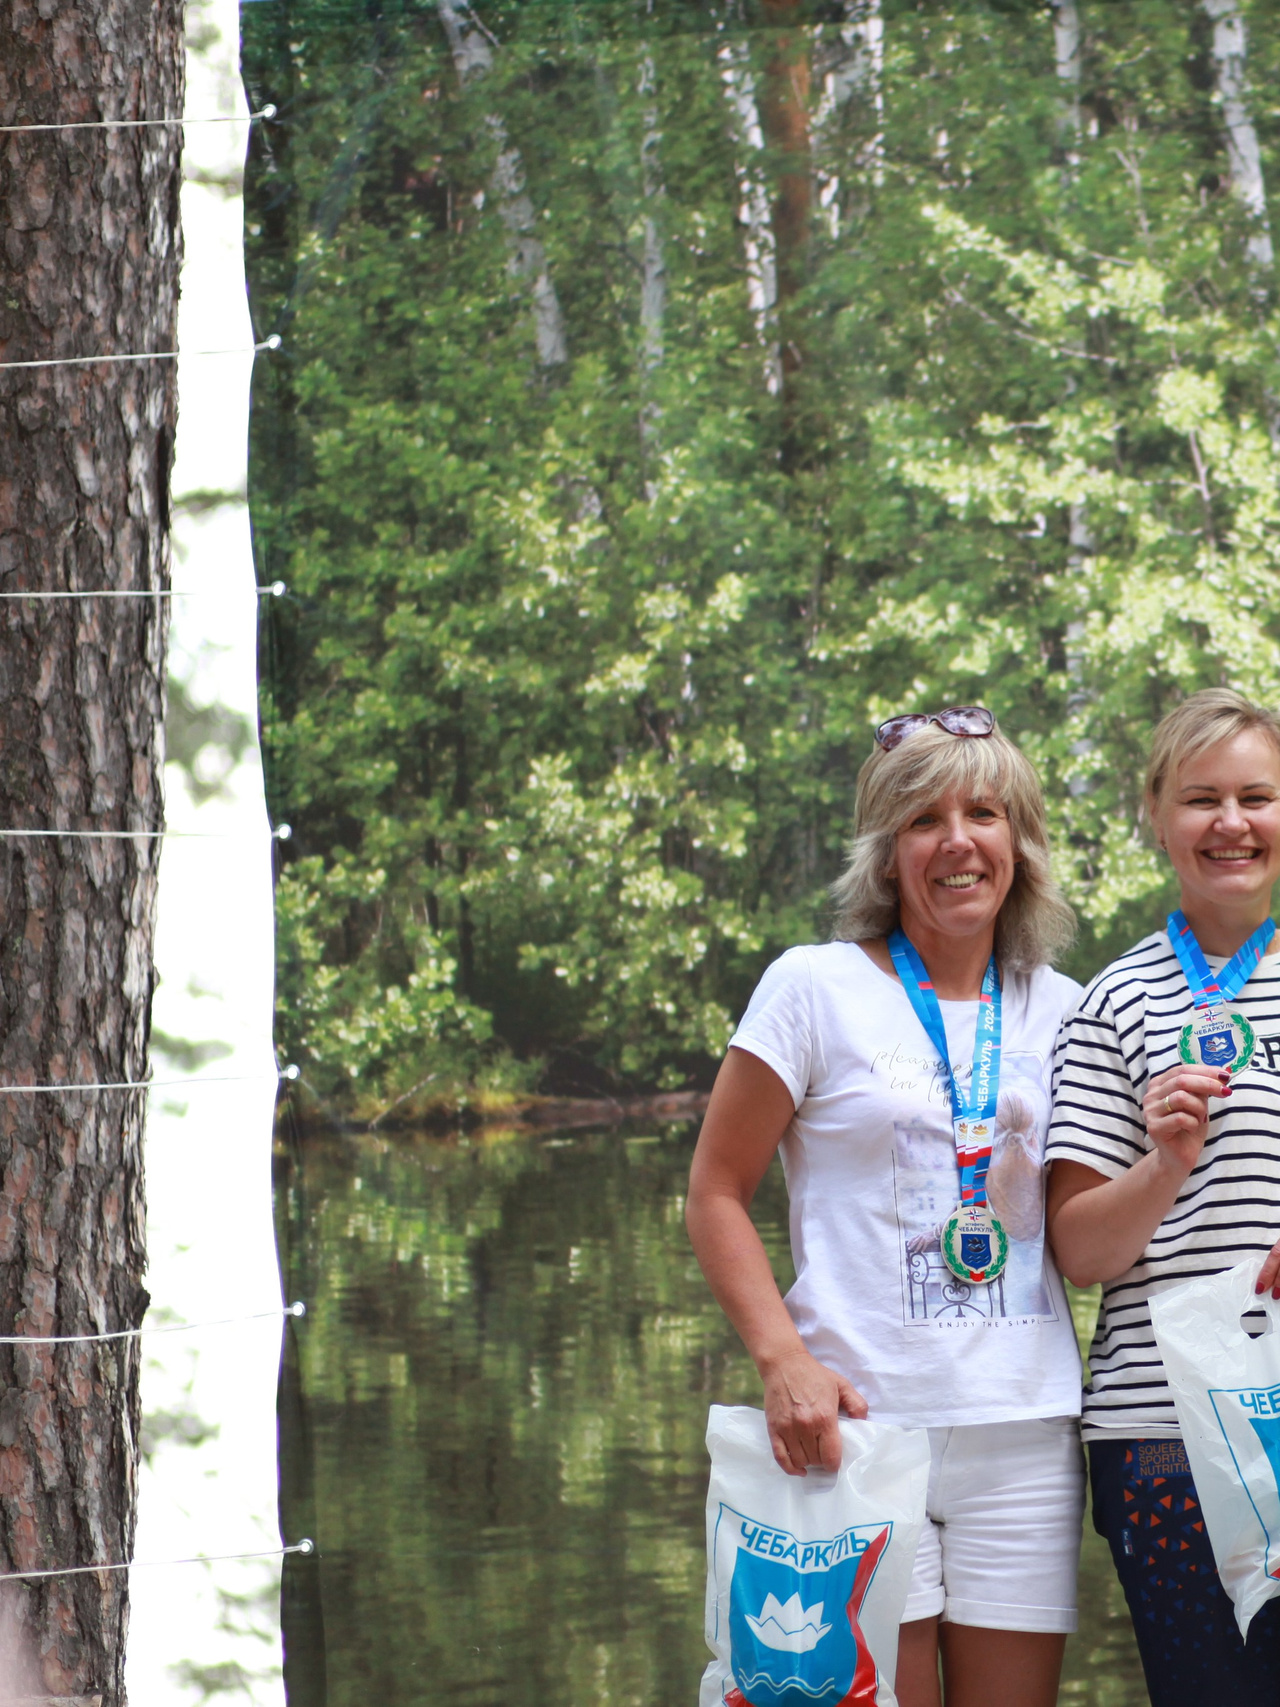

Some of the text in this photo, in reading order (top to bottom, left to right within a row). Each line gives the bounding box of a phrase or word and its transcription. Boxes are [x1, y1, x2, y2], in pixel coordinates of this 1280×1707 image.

[1194, 1022, 1235, 1036] ЧЕБАРКУЛЬ
[977, 1003, 995, 1111] ЧЕБАРКУЛЬ 2024
[1139, 1452, 1186, 1466] SPORTS
